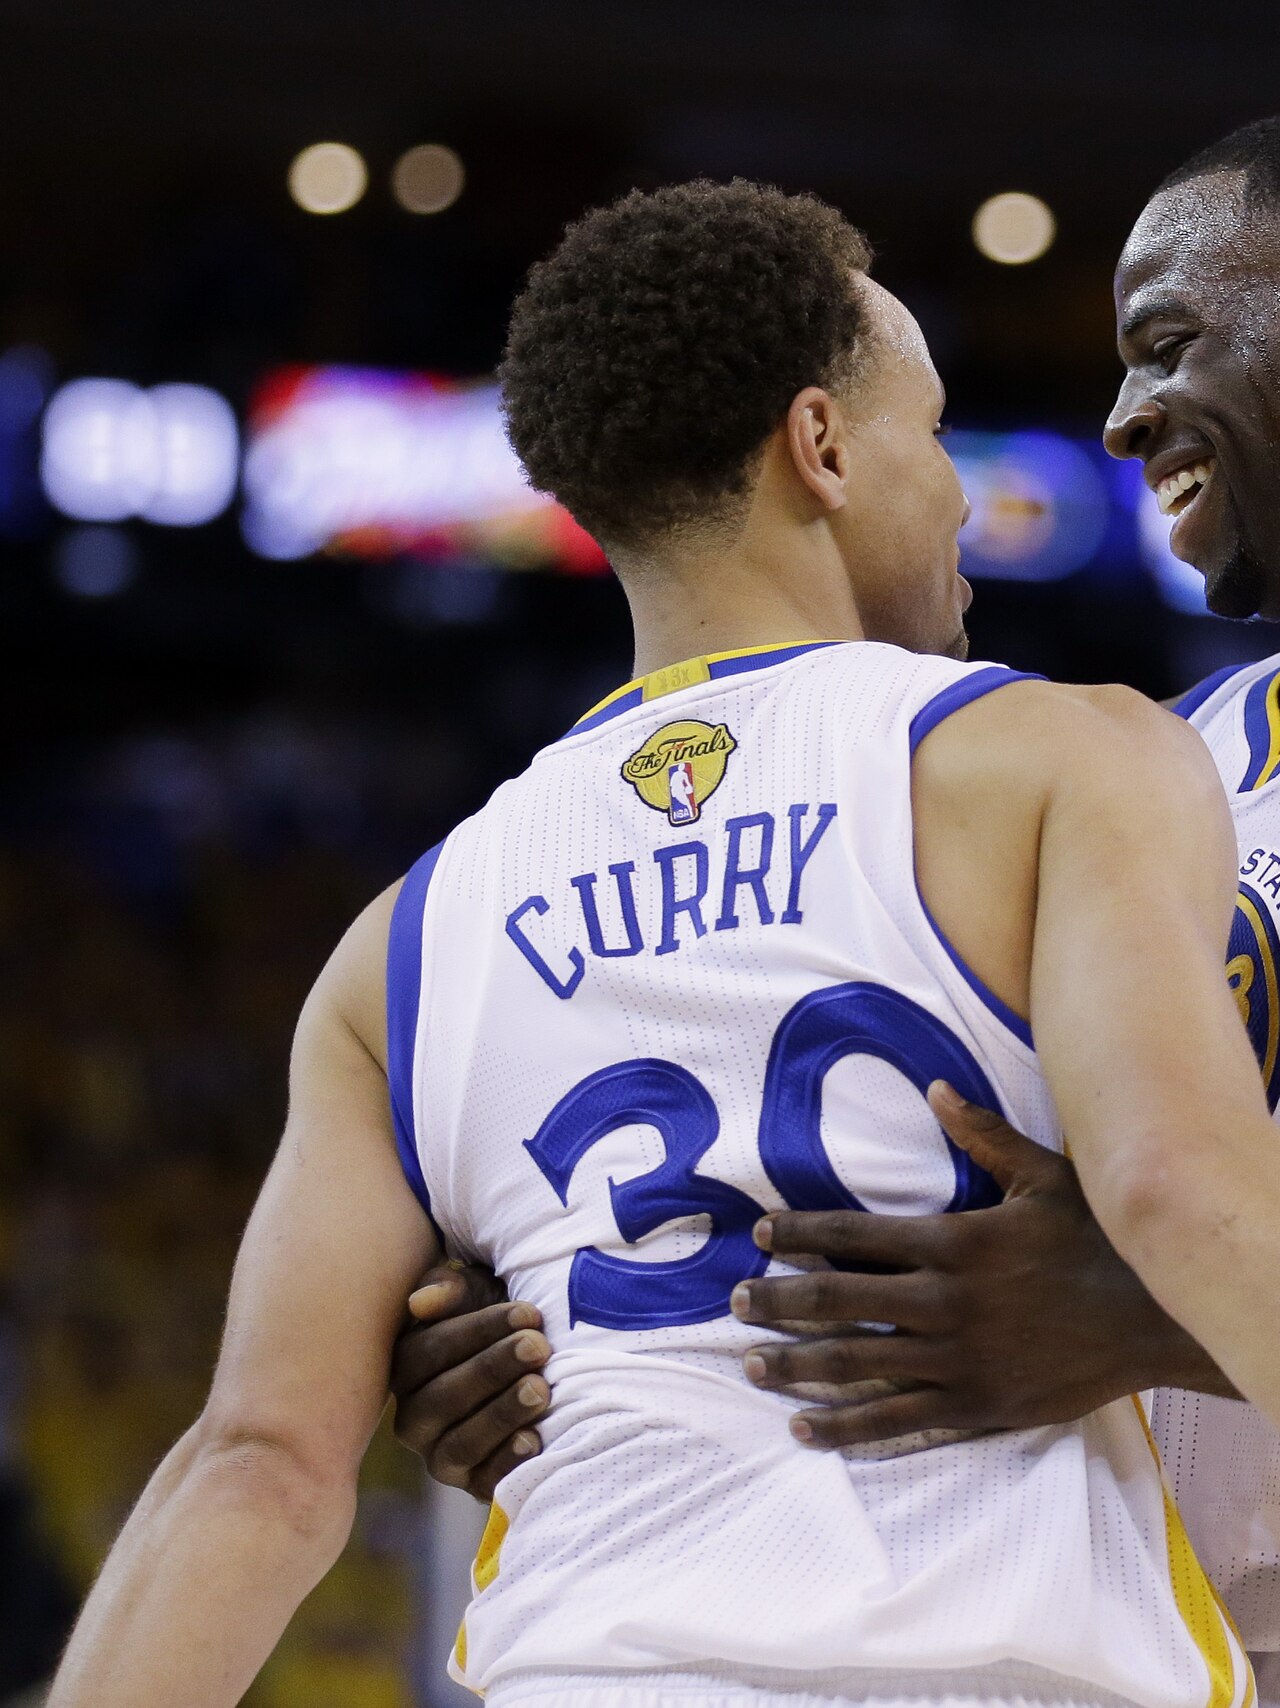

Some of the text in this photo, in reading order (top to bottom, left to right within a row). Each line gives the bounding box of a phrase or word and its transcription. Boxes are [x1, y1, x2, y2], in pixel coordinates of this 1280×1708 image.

[628, 729, 729, 776] The Finals
[505, 802, 838, 1000] CURRY
[522, 981, 1005, 1331] 30
